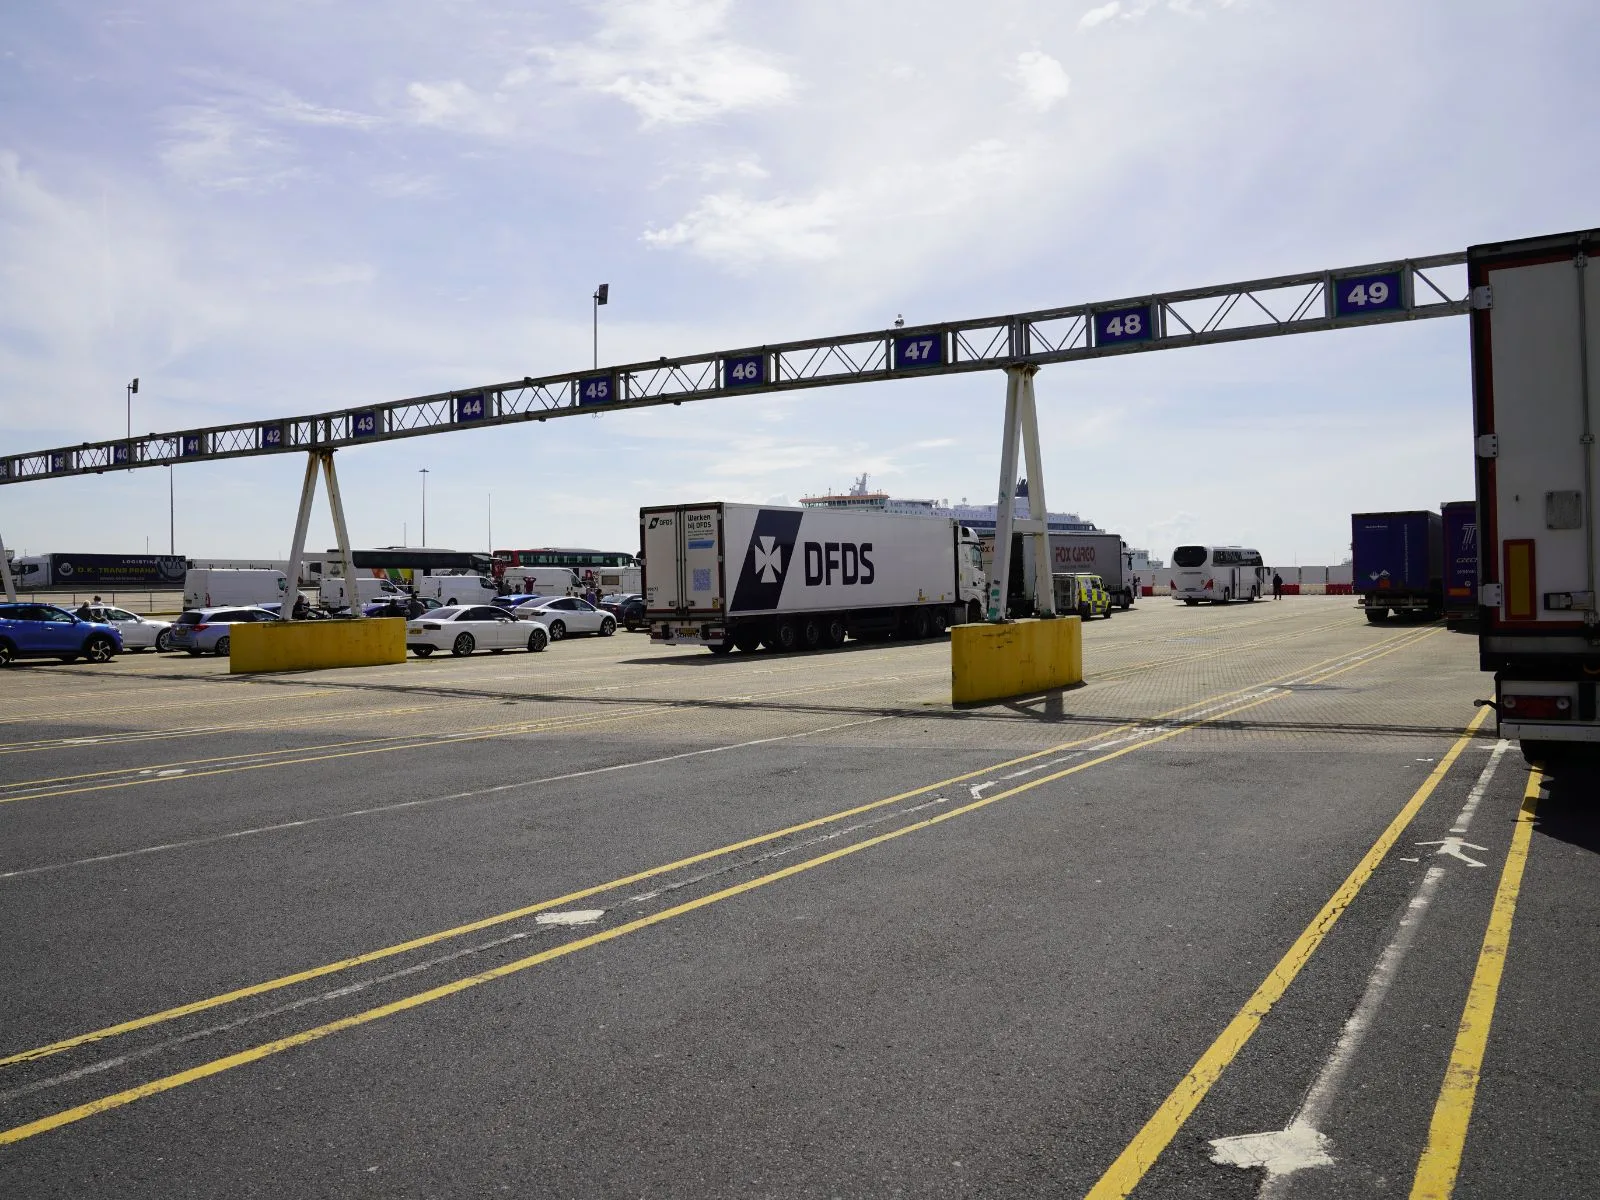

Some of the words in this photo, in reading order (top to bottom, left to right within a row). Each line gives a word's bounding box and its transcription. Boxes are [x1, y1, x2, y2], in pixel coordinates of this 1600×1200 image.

[1347, 281, 1389, 306] 49
[1106, 313, 1142, 337] 48
[904, 340, 933, 360] 47
[732, 361, 757, 380] 46
[585, 381, 608, 398] 45
[462, 400, 482, 415] 44
[357, 416, 374, 431] 43
[266, 429, 281, 443] 42
[188, 439, 199, 451] 41
[116, 448, 128, 459] 40
[687, 514, 711, 522] Werken
[696, 521, 712, 529] DFDS
[1055, 546, 1071, 562] FOX
[804, 541, 875, 587] DFDS
